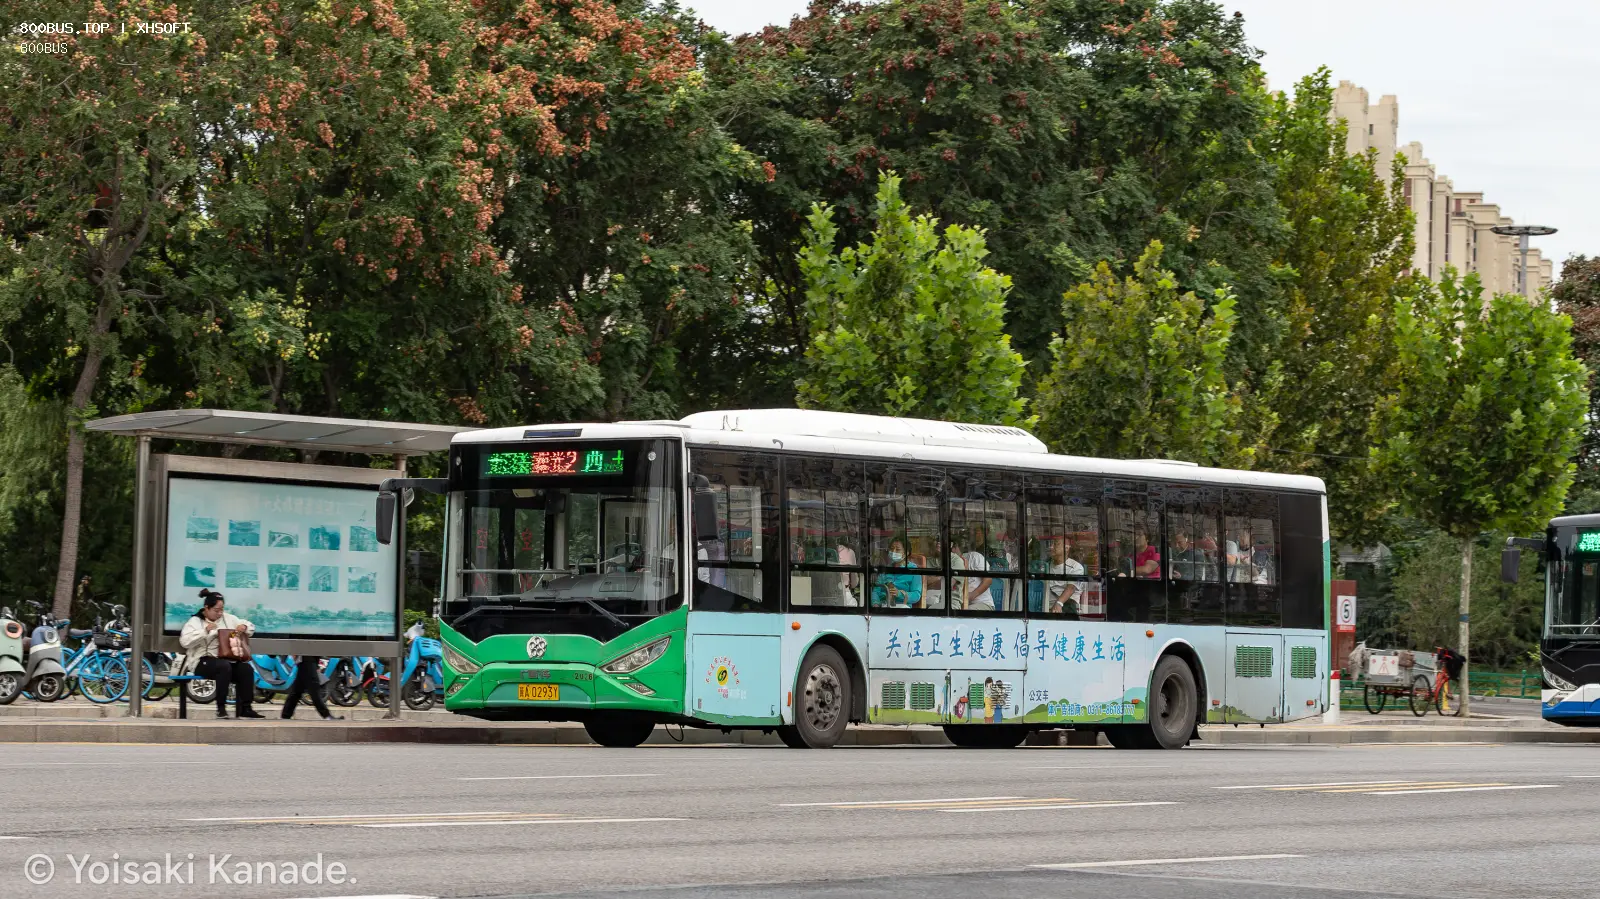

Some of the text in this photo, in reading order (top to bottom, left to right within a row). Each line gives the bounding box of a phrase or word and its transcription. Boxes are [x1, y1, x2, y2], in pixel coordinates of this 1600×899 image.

[1344, 604, 1350, 618] 5
[886, 627, 1126, 663] 关注卫生健康 倡导健康生活
[1028, 689, 1049, 702] 公交车
